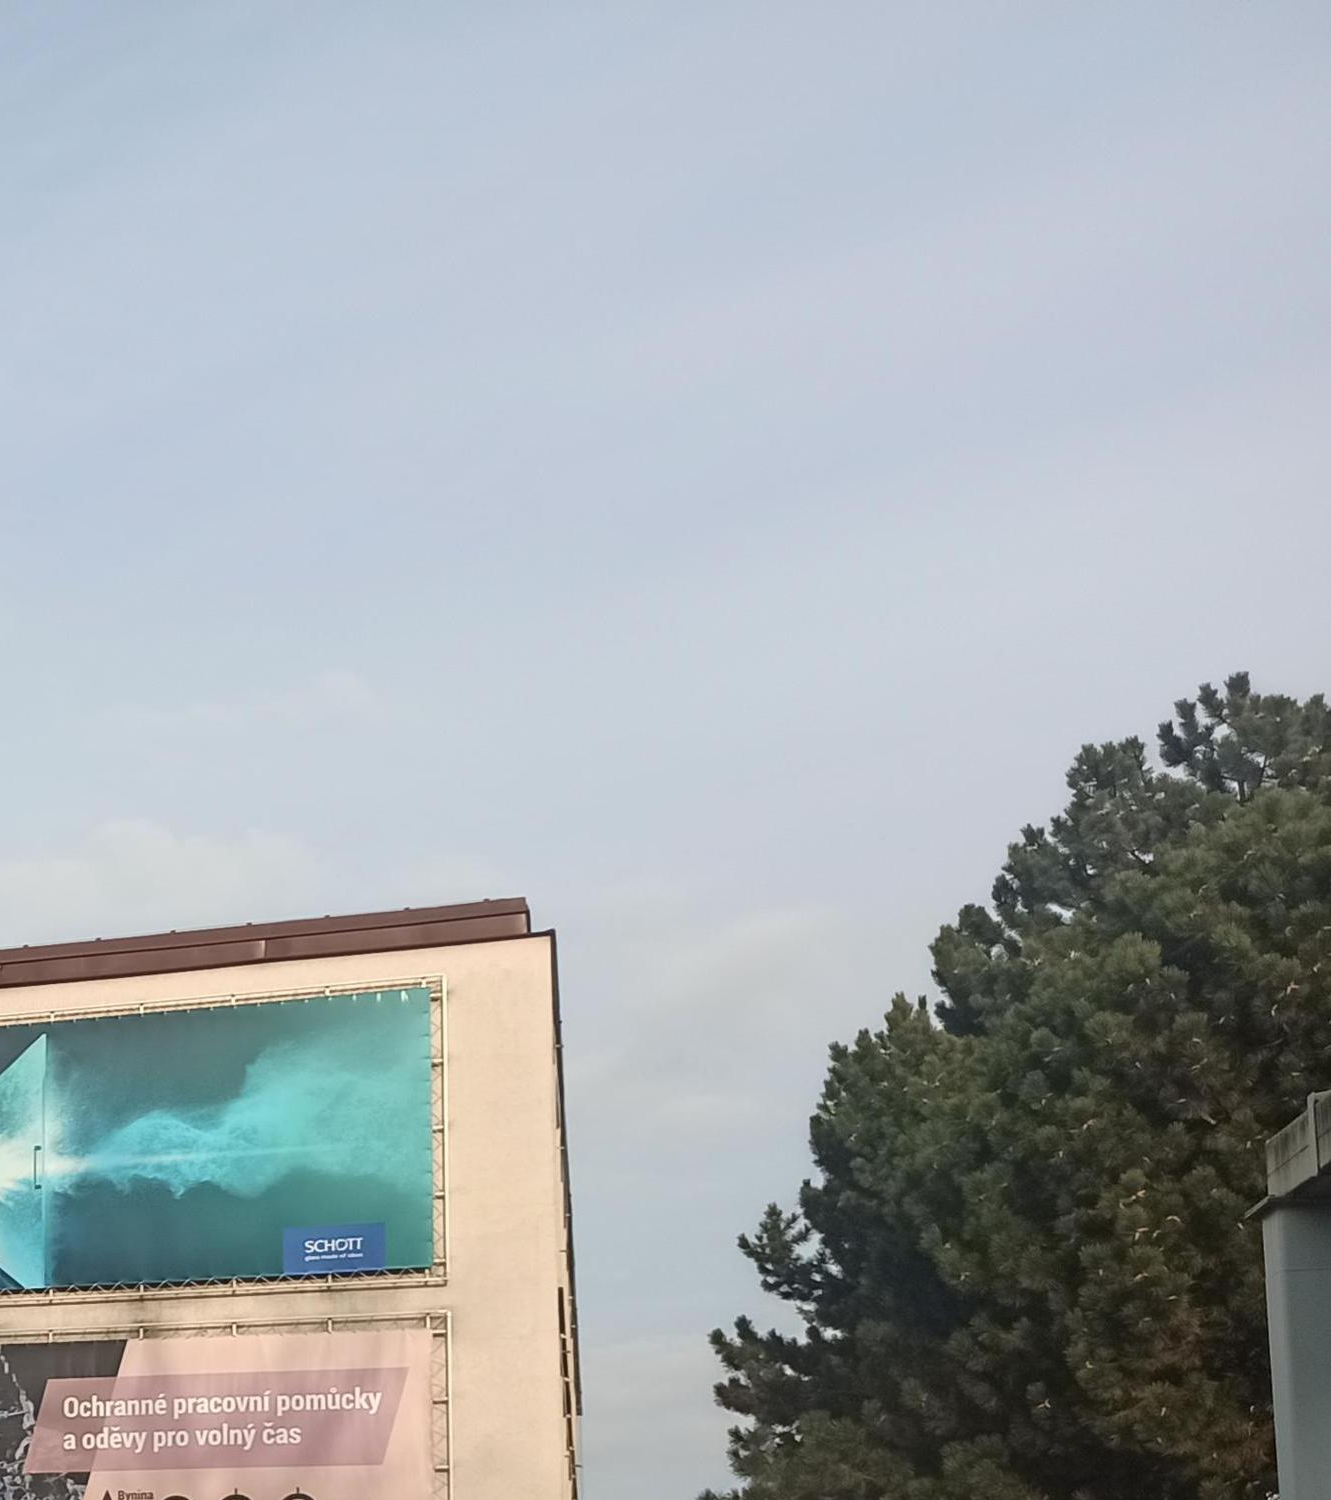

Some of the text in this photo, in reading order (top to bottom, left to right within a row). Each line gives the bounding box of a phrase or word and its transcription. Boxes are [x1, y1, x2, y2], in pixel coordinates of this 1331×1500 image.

[304, 1236, 364, 1253] SCHOTT
[63, 1386, 382, 1419] Ochranné pracovní pomůcky
[63, 1422, 301, 1453] a oděvy pro volný čas
